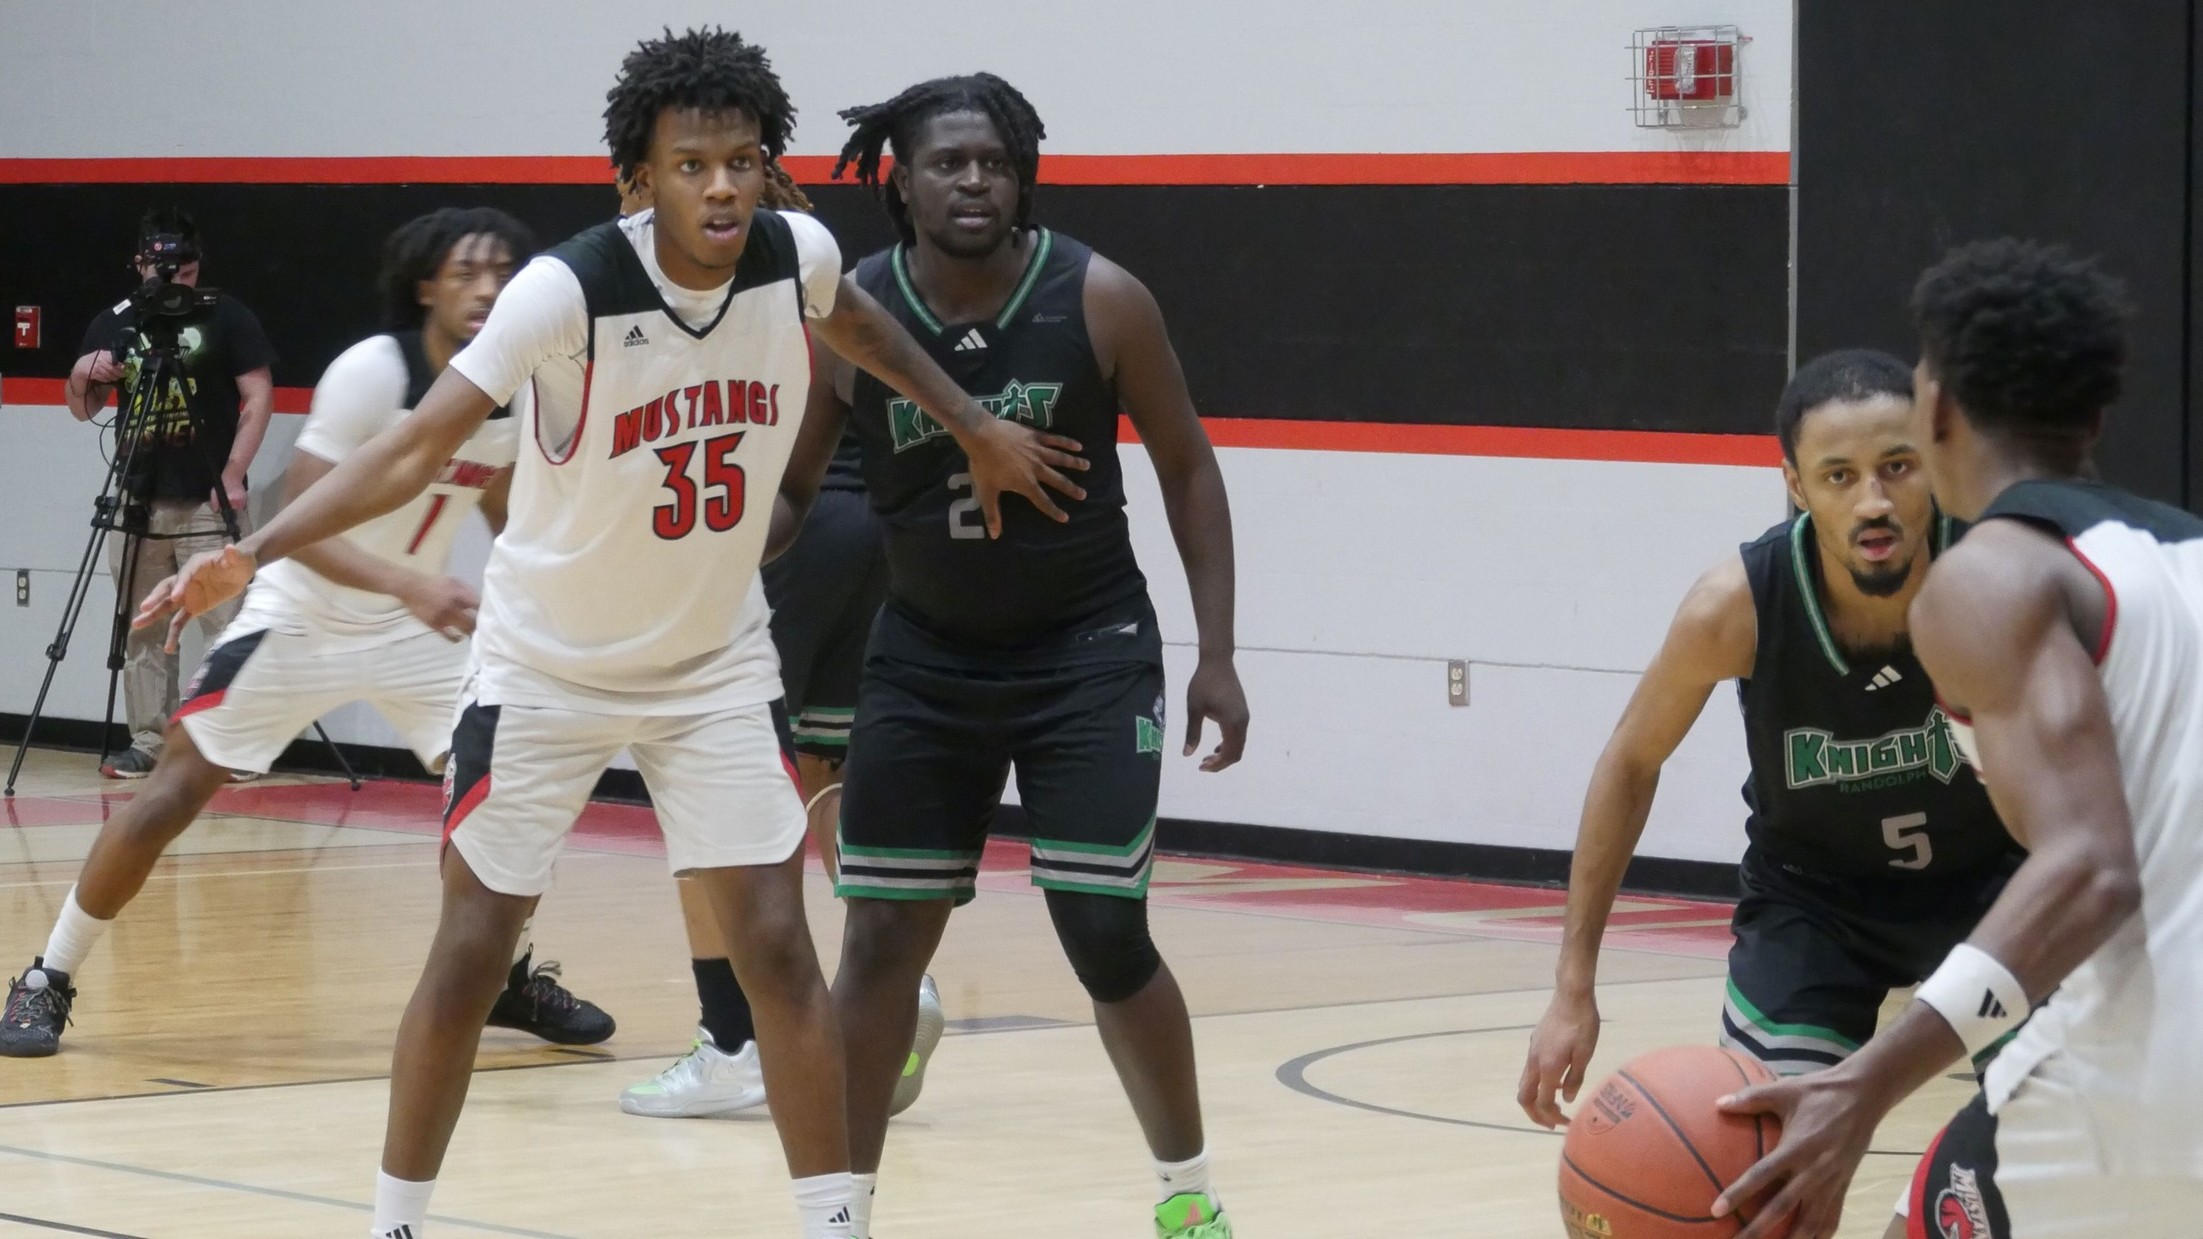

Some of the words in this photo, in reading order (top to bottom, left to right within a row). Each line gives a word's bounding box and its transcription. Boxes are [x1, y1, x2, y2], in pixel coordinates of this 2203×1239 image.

[624, 338, 649, 348] adidas
[608, 379, 780, 460] MUSTANGS
[653, 430, 747, 540] 35
[405, 493, 452, 555] 1
[1785, 704, 1970, 789] KNIGHT
[1839, 770, 1927, 794] RANDOLPH
[1881, 811, 1933, 870] 5
